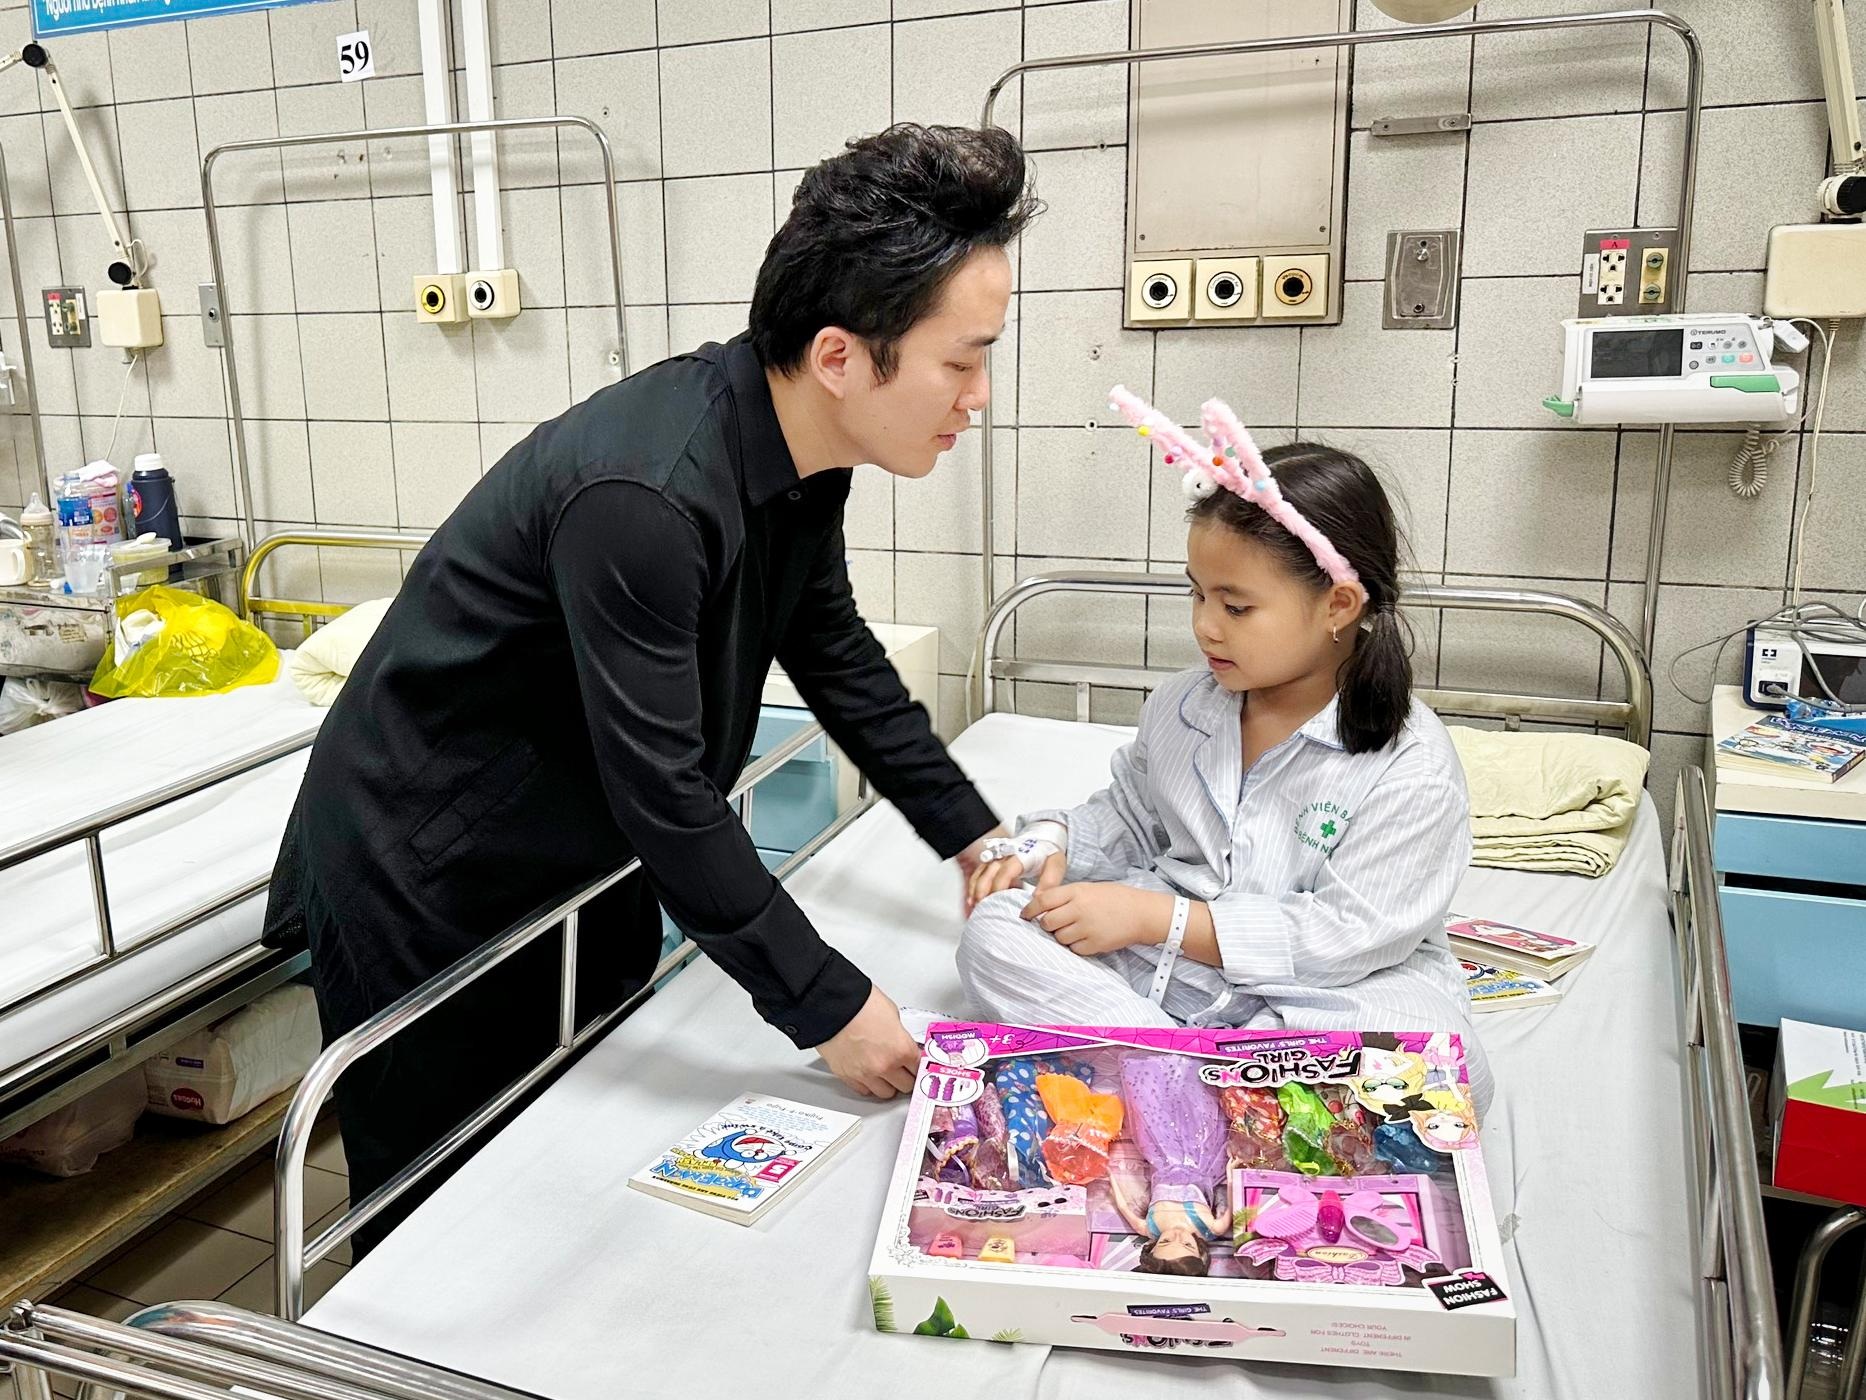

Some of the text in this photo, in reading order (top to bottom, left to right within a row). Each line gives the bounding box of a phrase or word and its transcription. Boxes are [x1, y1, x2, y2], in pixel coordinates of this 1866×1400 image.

[341, 40, 369, 74] 59
[989, 1033, 1015, 1045] 3+
[1277, 1039, 1306, 1048] GIRLS'
[1224, 1041, 1275, 1052] FAVORITES
[1256, 1050, 1307, 1064] GIRL
[939, 1066, 972, 1078] SHOES
[1204, 1051, 1361, 1083] FASHIONS
[766, 1129, 784, 1140] take
[946, 1205, 1024, 1218] FASHIONS
[1443, 1279, 1482, 1293] SHOW
[1443, 1287, 1498, 1305] FASHION
[1320, 1346, 1360, 1355] DIFFERENT
